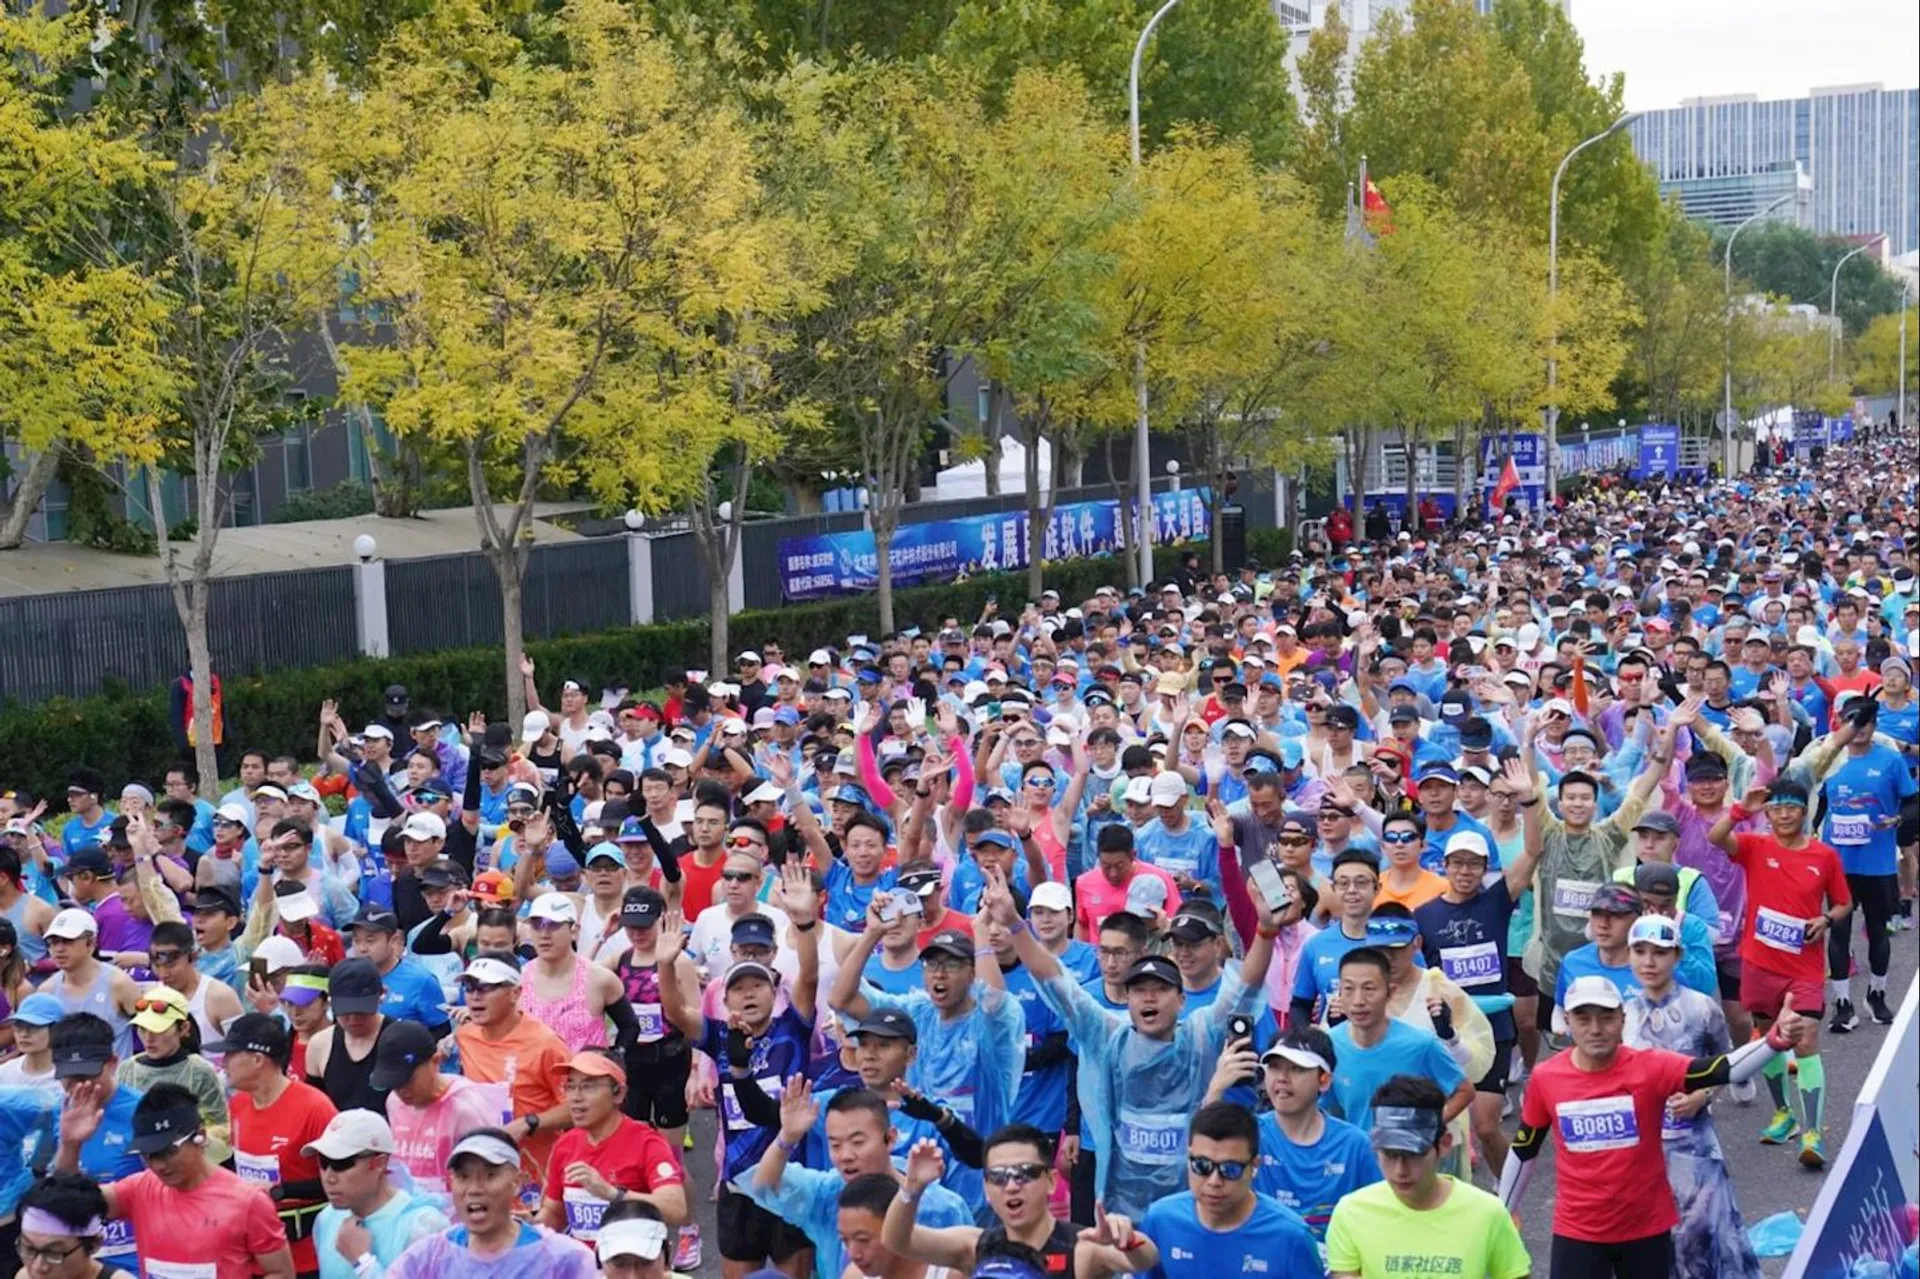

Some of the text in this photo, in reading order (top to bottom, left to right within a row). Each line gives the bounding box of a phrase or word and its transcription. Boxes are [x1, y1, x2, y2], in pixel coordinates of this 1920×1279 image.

[1453, 957, 1492, 975] B1407
[1571, 1113, 1626, 1138] B0813
[1130, 1130, 1178, 1148] B0601
